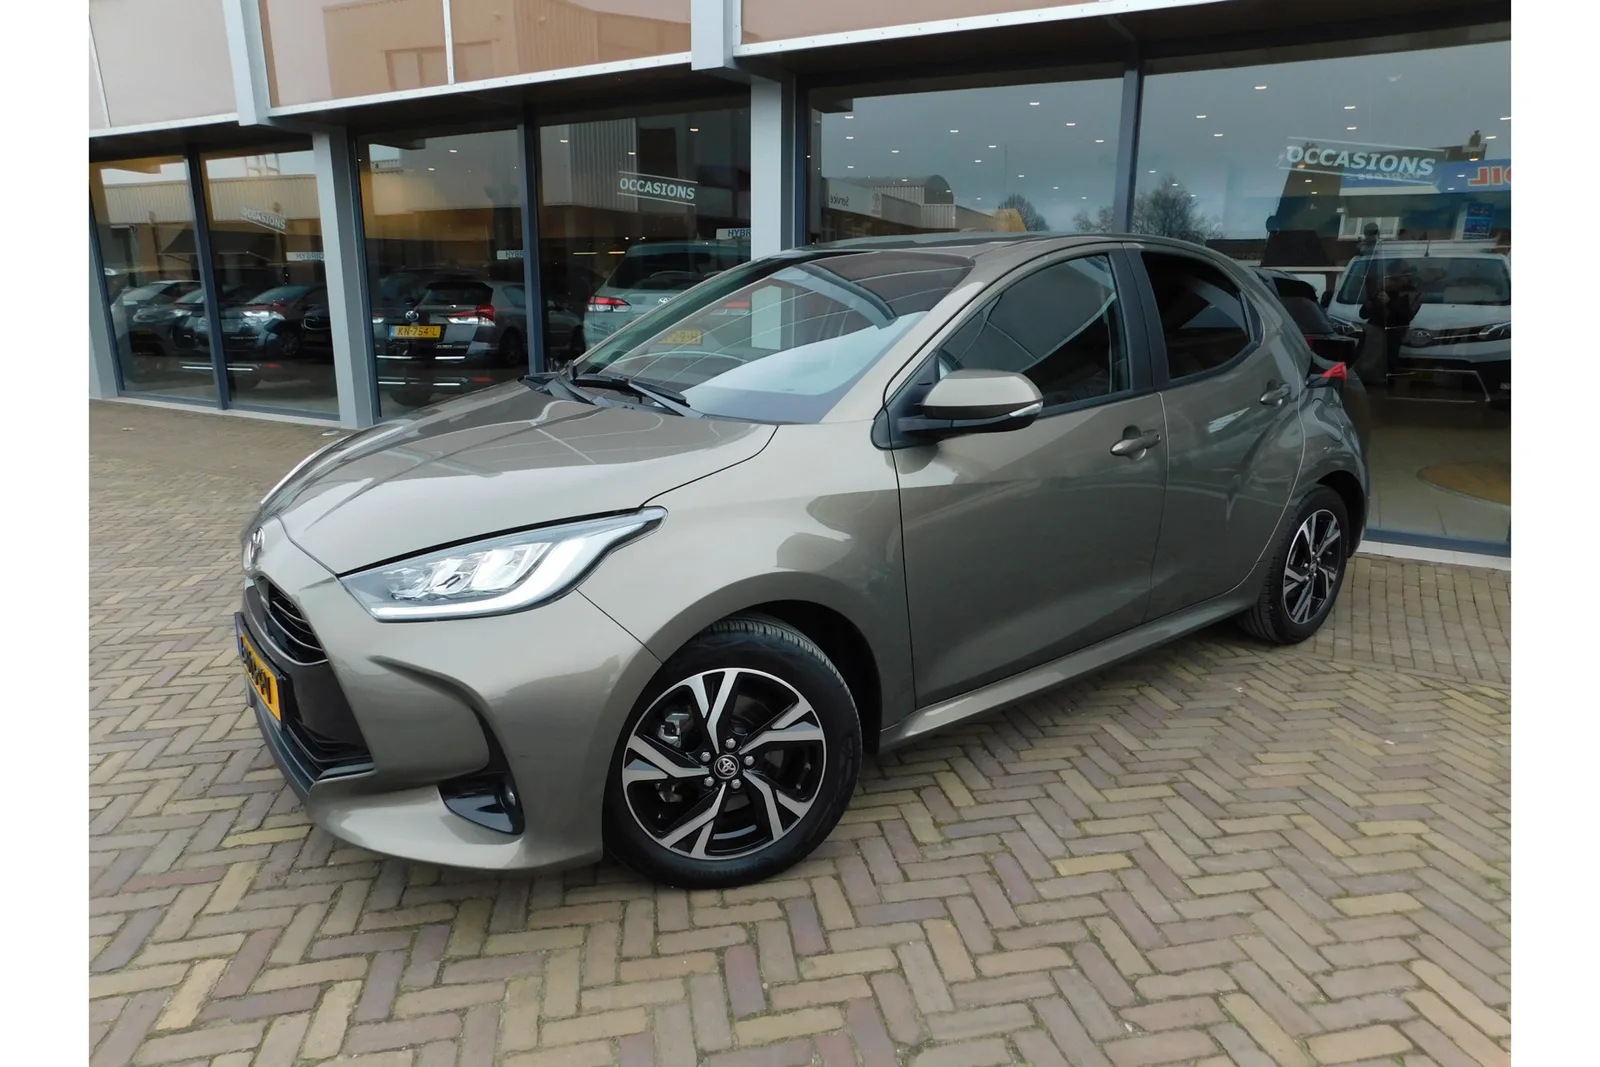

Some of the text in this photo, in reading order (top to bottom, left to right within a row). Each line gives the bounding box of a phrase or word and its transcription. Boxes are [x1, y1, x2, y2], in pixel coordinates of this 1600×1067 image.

[1286, 145, 1436, 176] OCCASIONS
[619, 177, 696, 200] OCCASIONS
[241, 206, 286, 230] OCCASIONS
